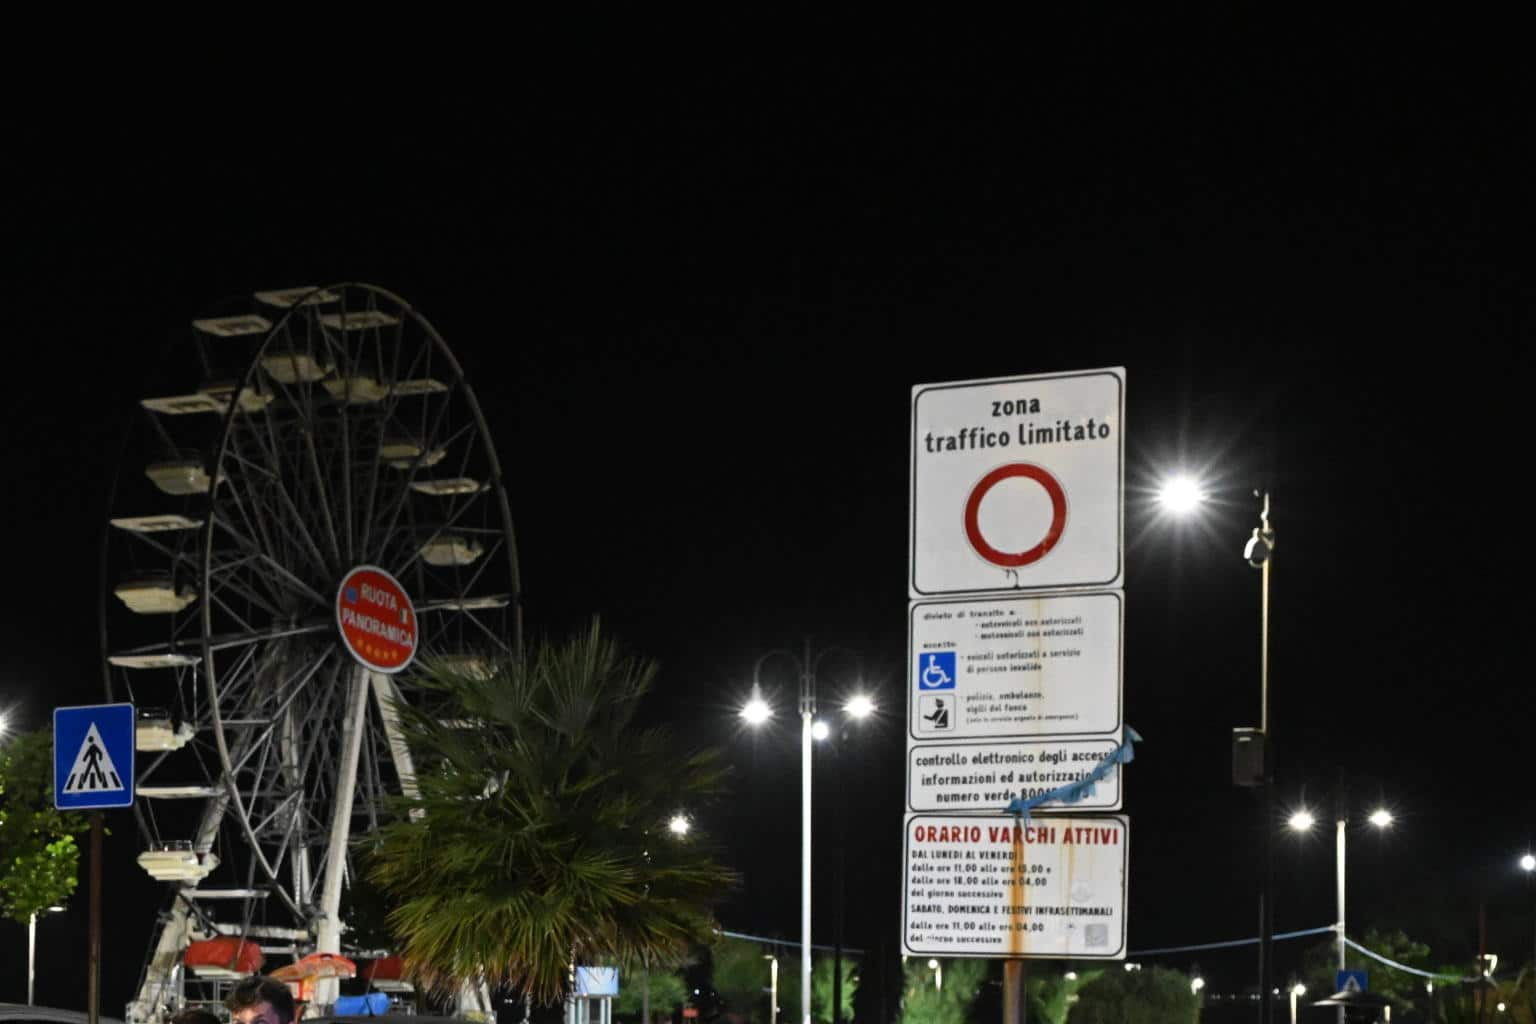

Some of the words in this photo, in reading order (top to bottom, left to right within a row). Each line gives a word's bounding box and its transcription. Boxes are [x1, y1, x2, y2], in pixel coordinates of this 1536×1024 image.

[992, 398, 1041, 417] zona
[925, 426, 1011, 453] traffico
[1018, 418, 1110, 446] limitato
[361, 583, 398, 610] RUOTA
[342, 607, 413, 647] PANORAMICA
[916, 751, 968, 767] controllo
[971, 749, 1035, 766] elettronico
[1039, 748, 1067, 764] degli
[920, 772, 997, 787] informazioni
[1000, 770, 1014, 784] ed
[936, 790, 980, 804] numero
[984, 788, 1016, 803] verde
[914, 825, 982, 844] ORARIO
[988, 826, 1056, 845] VARCHI
[1063, 827, 1119, 846] ATTIVI
[911, 849, 927, 859] DAL
[965, 850, 976, 860] AL
[911, 863, 934, 873] dalle
[936, 865, 951, 873] ore
[980, 863, 998, 873] alle
[911, 875, 934, 885] dalle
[936, 877, 951, 885] ore
[981, 876, 999, 886] alle
[1002, 878, 1016, 886] ore
[911, 887, 924, 897] del
[927, 889, 955, 899] giorno
[957, 889, 1004, 899] successivo
[911, 903, 945, 914] SABATO,
[948, 904, 991, 914] DOMENICA
[993, 905, 999, 915] E
[1001, 905, 1033, 916] FESTIVI
[1035, 906, 1113, 917] INFRASETTIMANALI
[910, 921, 933, 930] dalle
[978, 922, 996, 931] alle
[999, 924, 1013, 932] ore
[910, 933, 923, 943] del
[956, 936, 1003, 944] successivo
